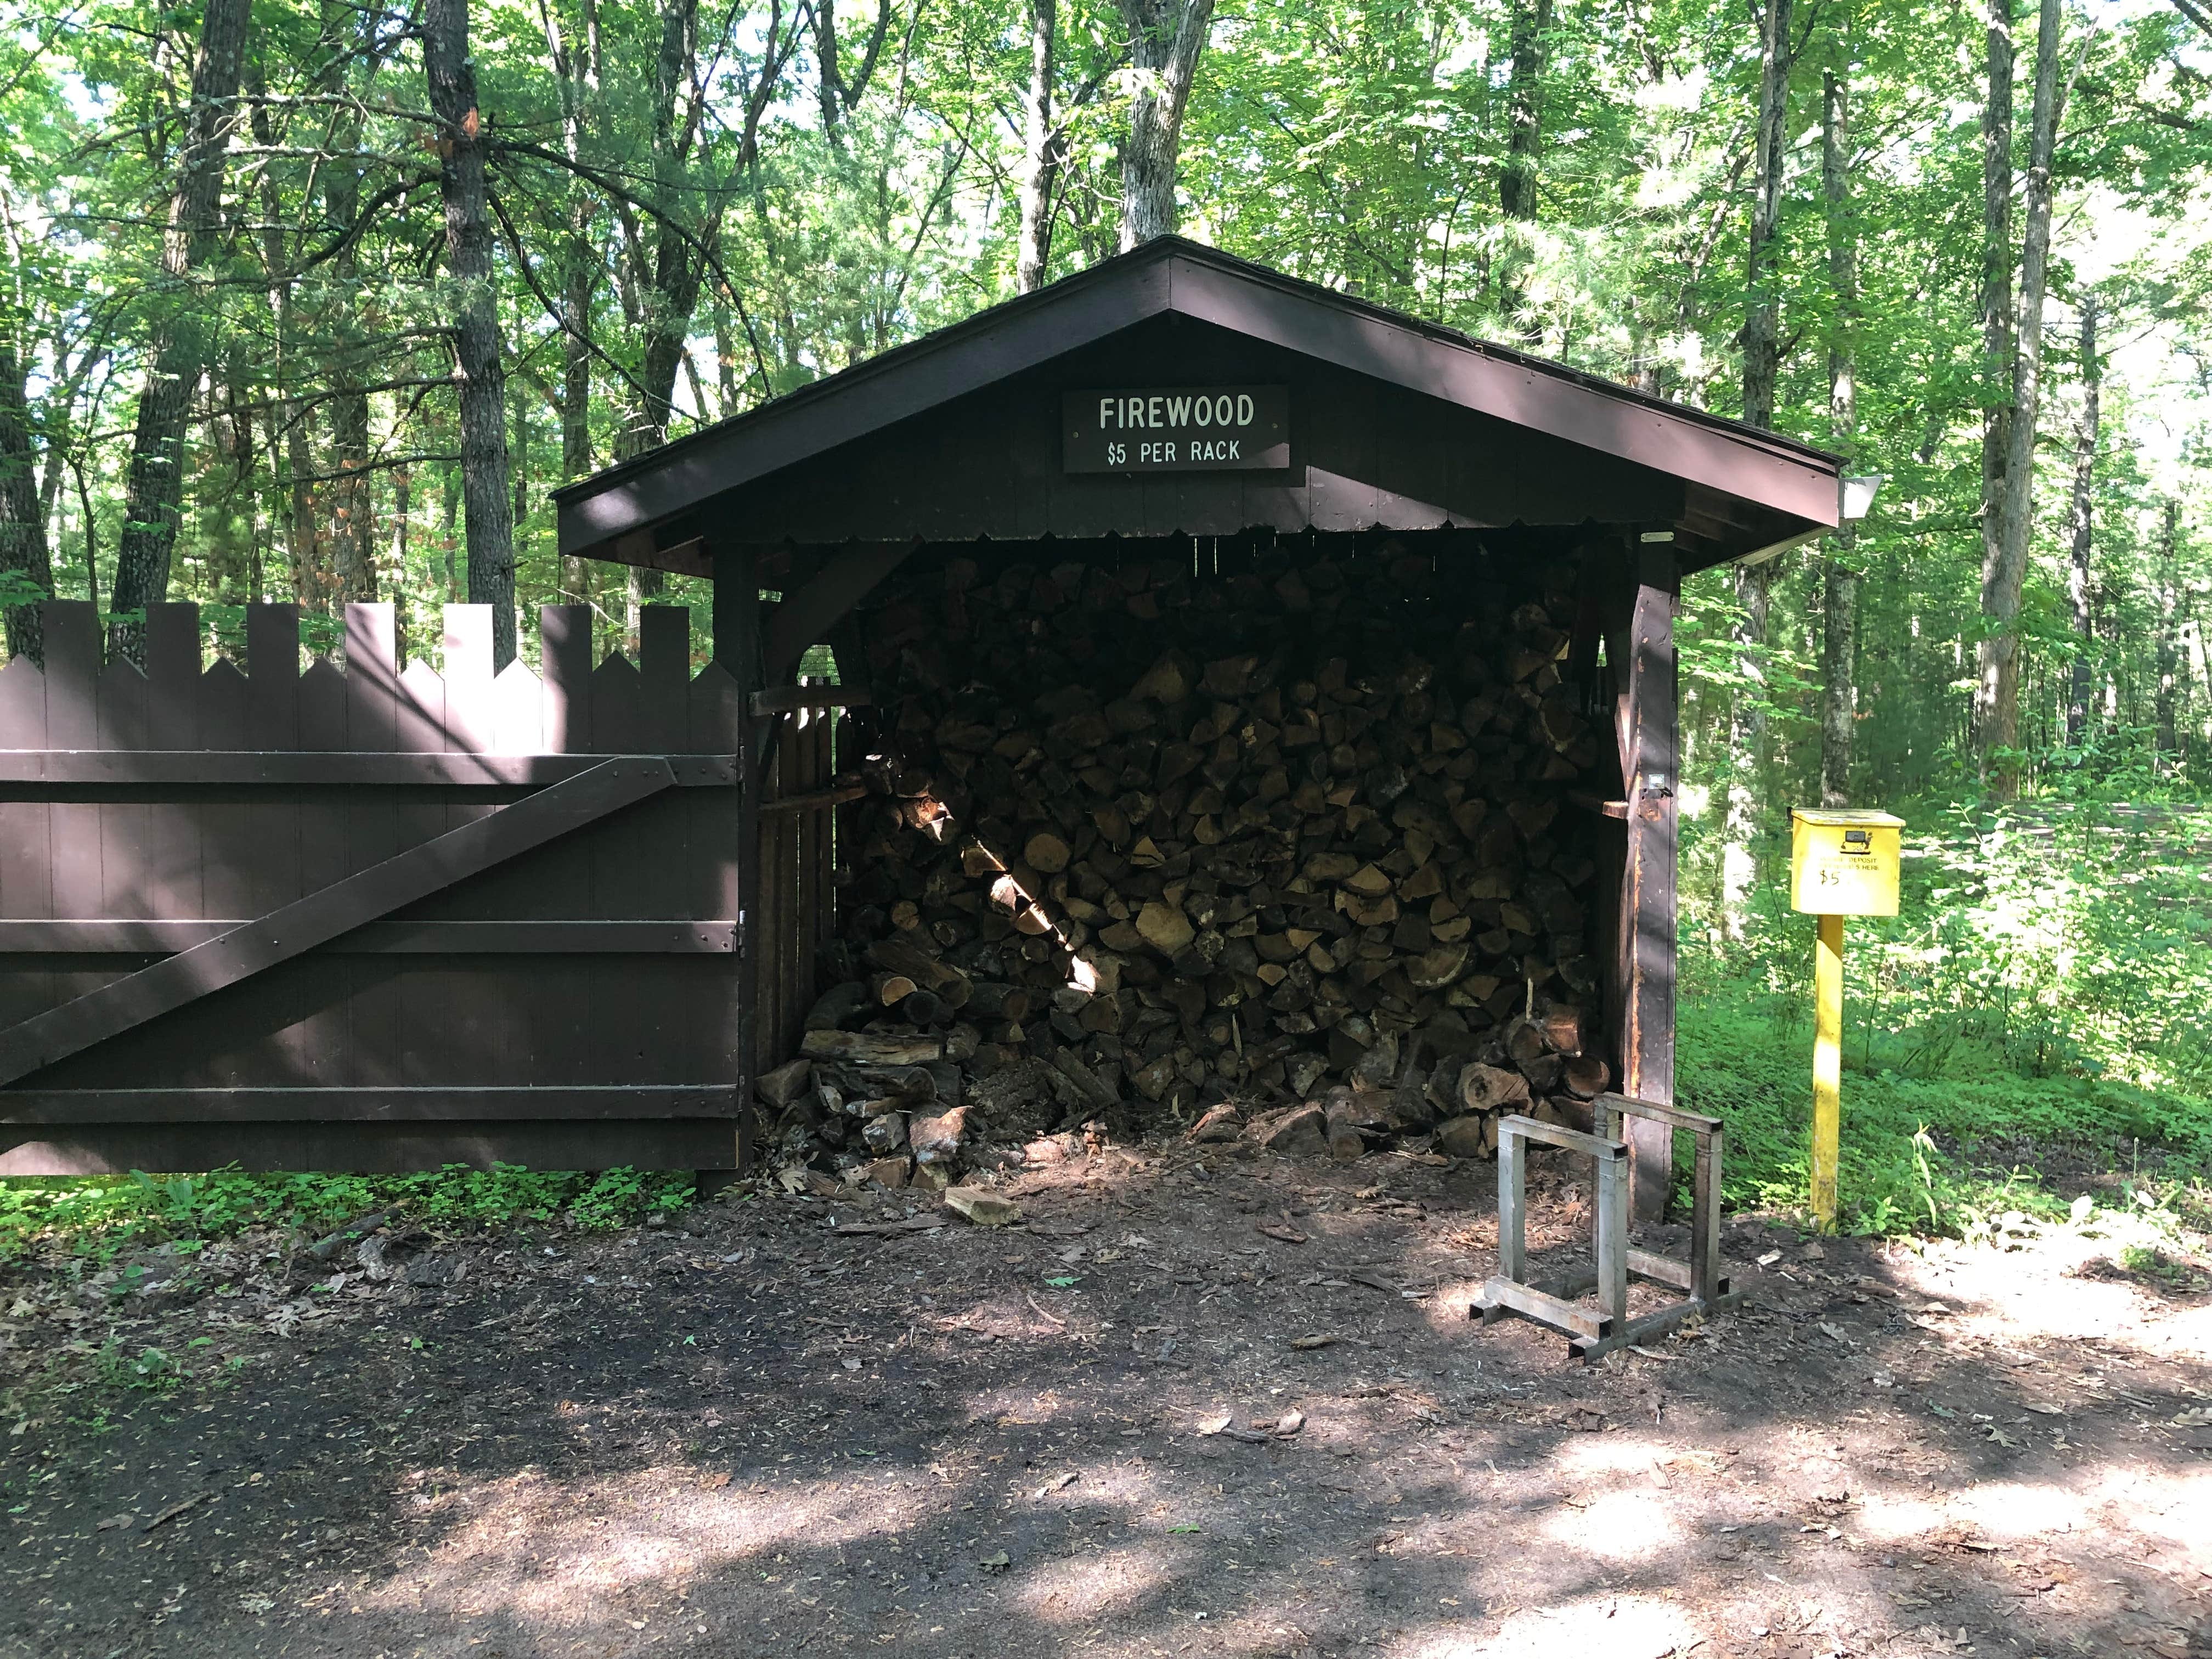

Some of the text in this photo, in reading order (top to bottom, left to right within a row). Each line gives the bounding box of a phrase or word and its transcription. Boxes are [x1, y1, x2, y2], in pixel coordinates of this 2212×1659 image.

[1100, 394, 1254, 429] FIREWOOD
[1108, 440, 1240, 465] $5 PER RACK
